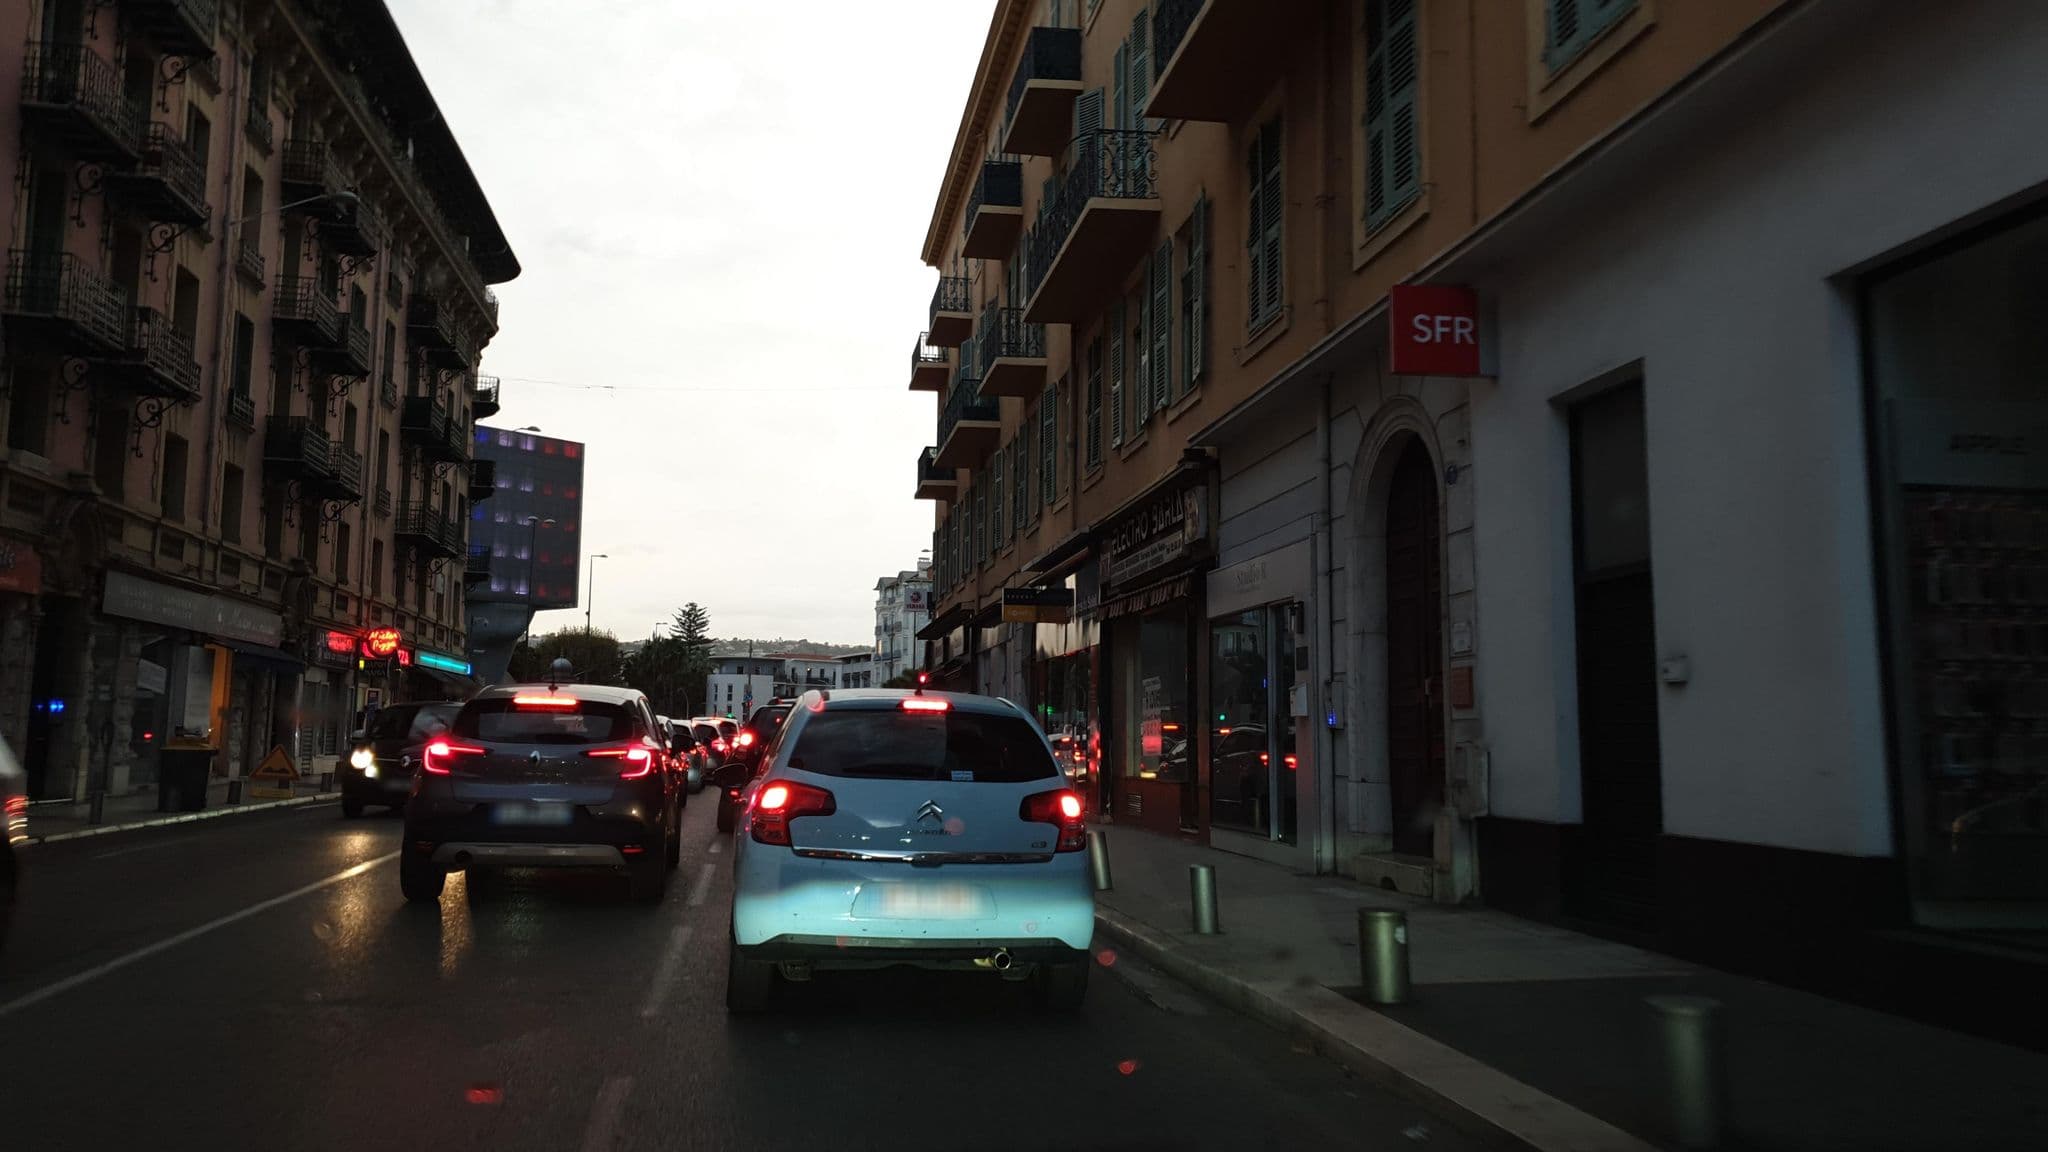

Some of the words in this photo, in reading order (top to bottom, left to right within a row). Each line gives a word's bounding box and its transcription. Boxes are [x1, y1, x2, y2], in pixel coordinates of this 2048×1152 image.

[1412, 313, 1476, 345] SFR
[1111, 510, 1149, 556] ELECTRO
[1151, 487, 1184, 535] BARLA
[368, 630, 398, 641] Mister
[372, 639, 397, 652] Pizza
